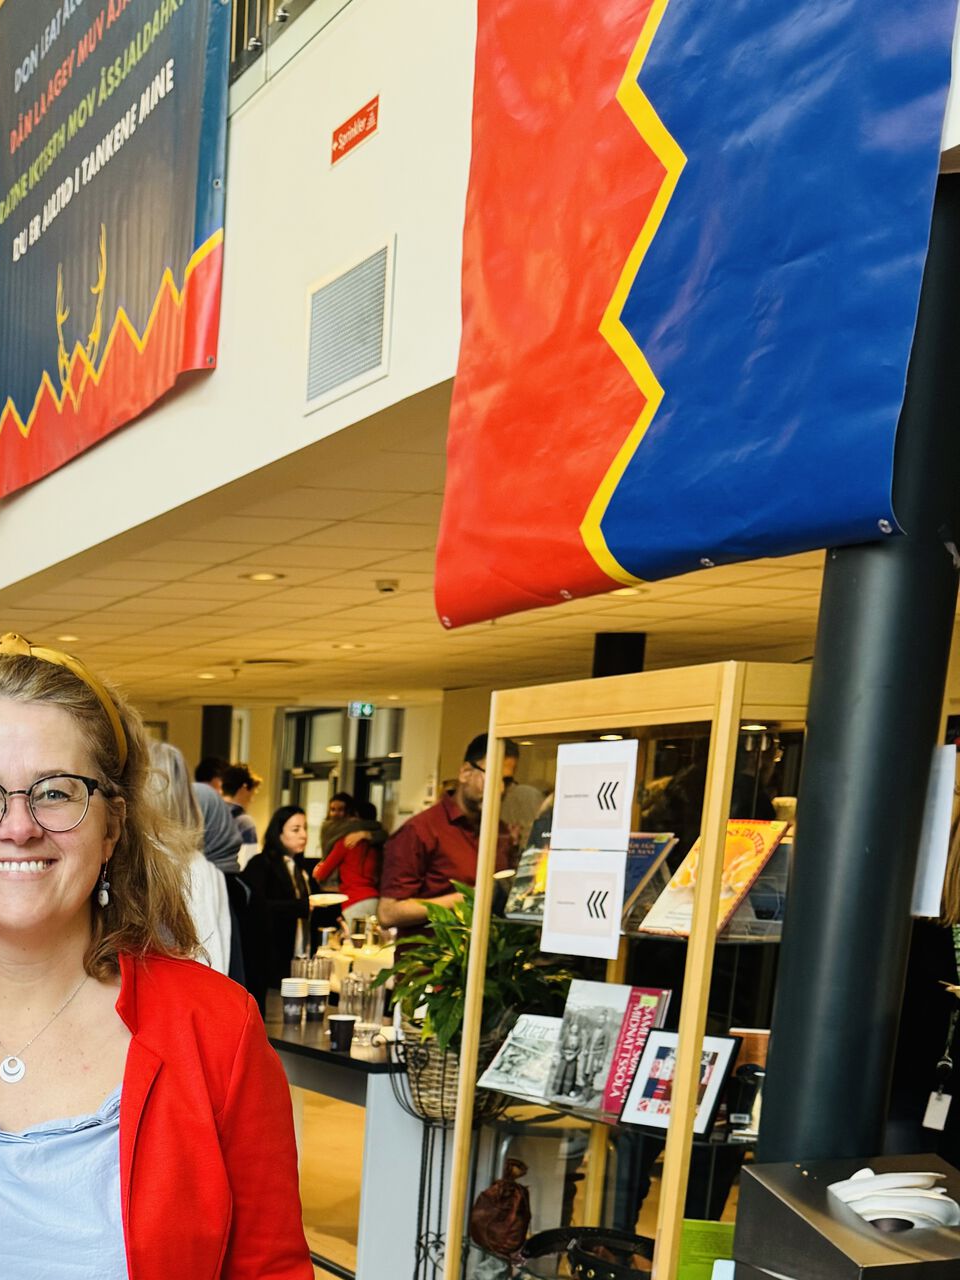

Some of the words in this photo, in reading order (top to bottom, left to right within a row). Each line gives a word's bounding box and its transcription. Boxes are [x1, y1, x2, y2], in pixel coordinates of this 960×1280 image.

[14, 43, 39, 94] DON
[41, 8, 62, 60] LEAT
[77, 9, 105, 67] MUV
[66, 87, 96, 141] MOV
[12, 228, 28, 262] DU
[28, 214, 42, 247] ER
[73, 166, 80, 194] I
[81, 103, 138, 186] TANKENE
[138, 58, 175, 125] MINE
